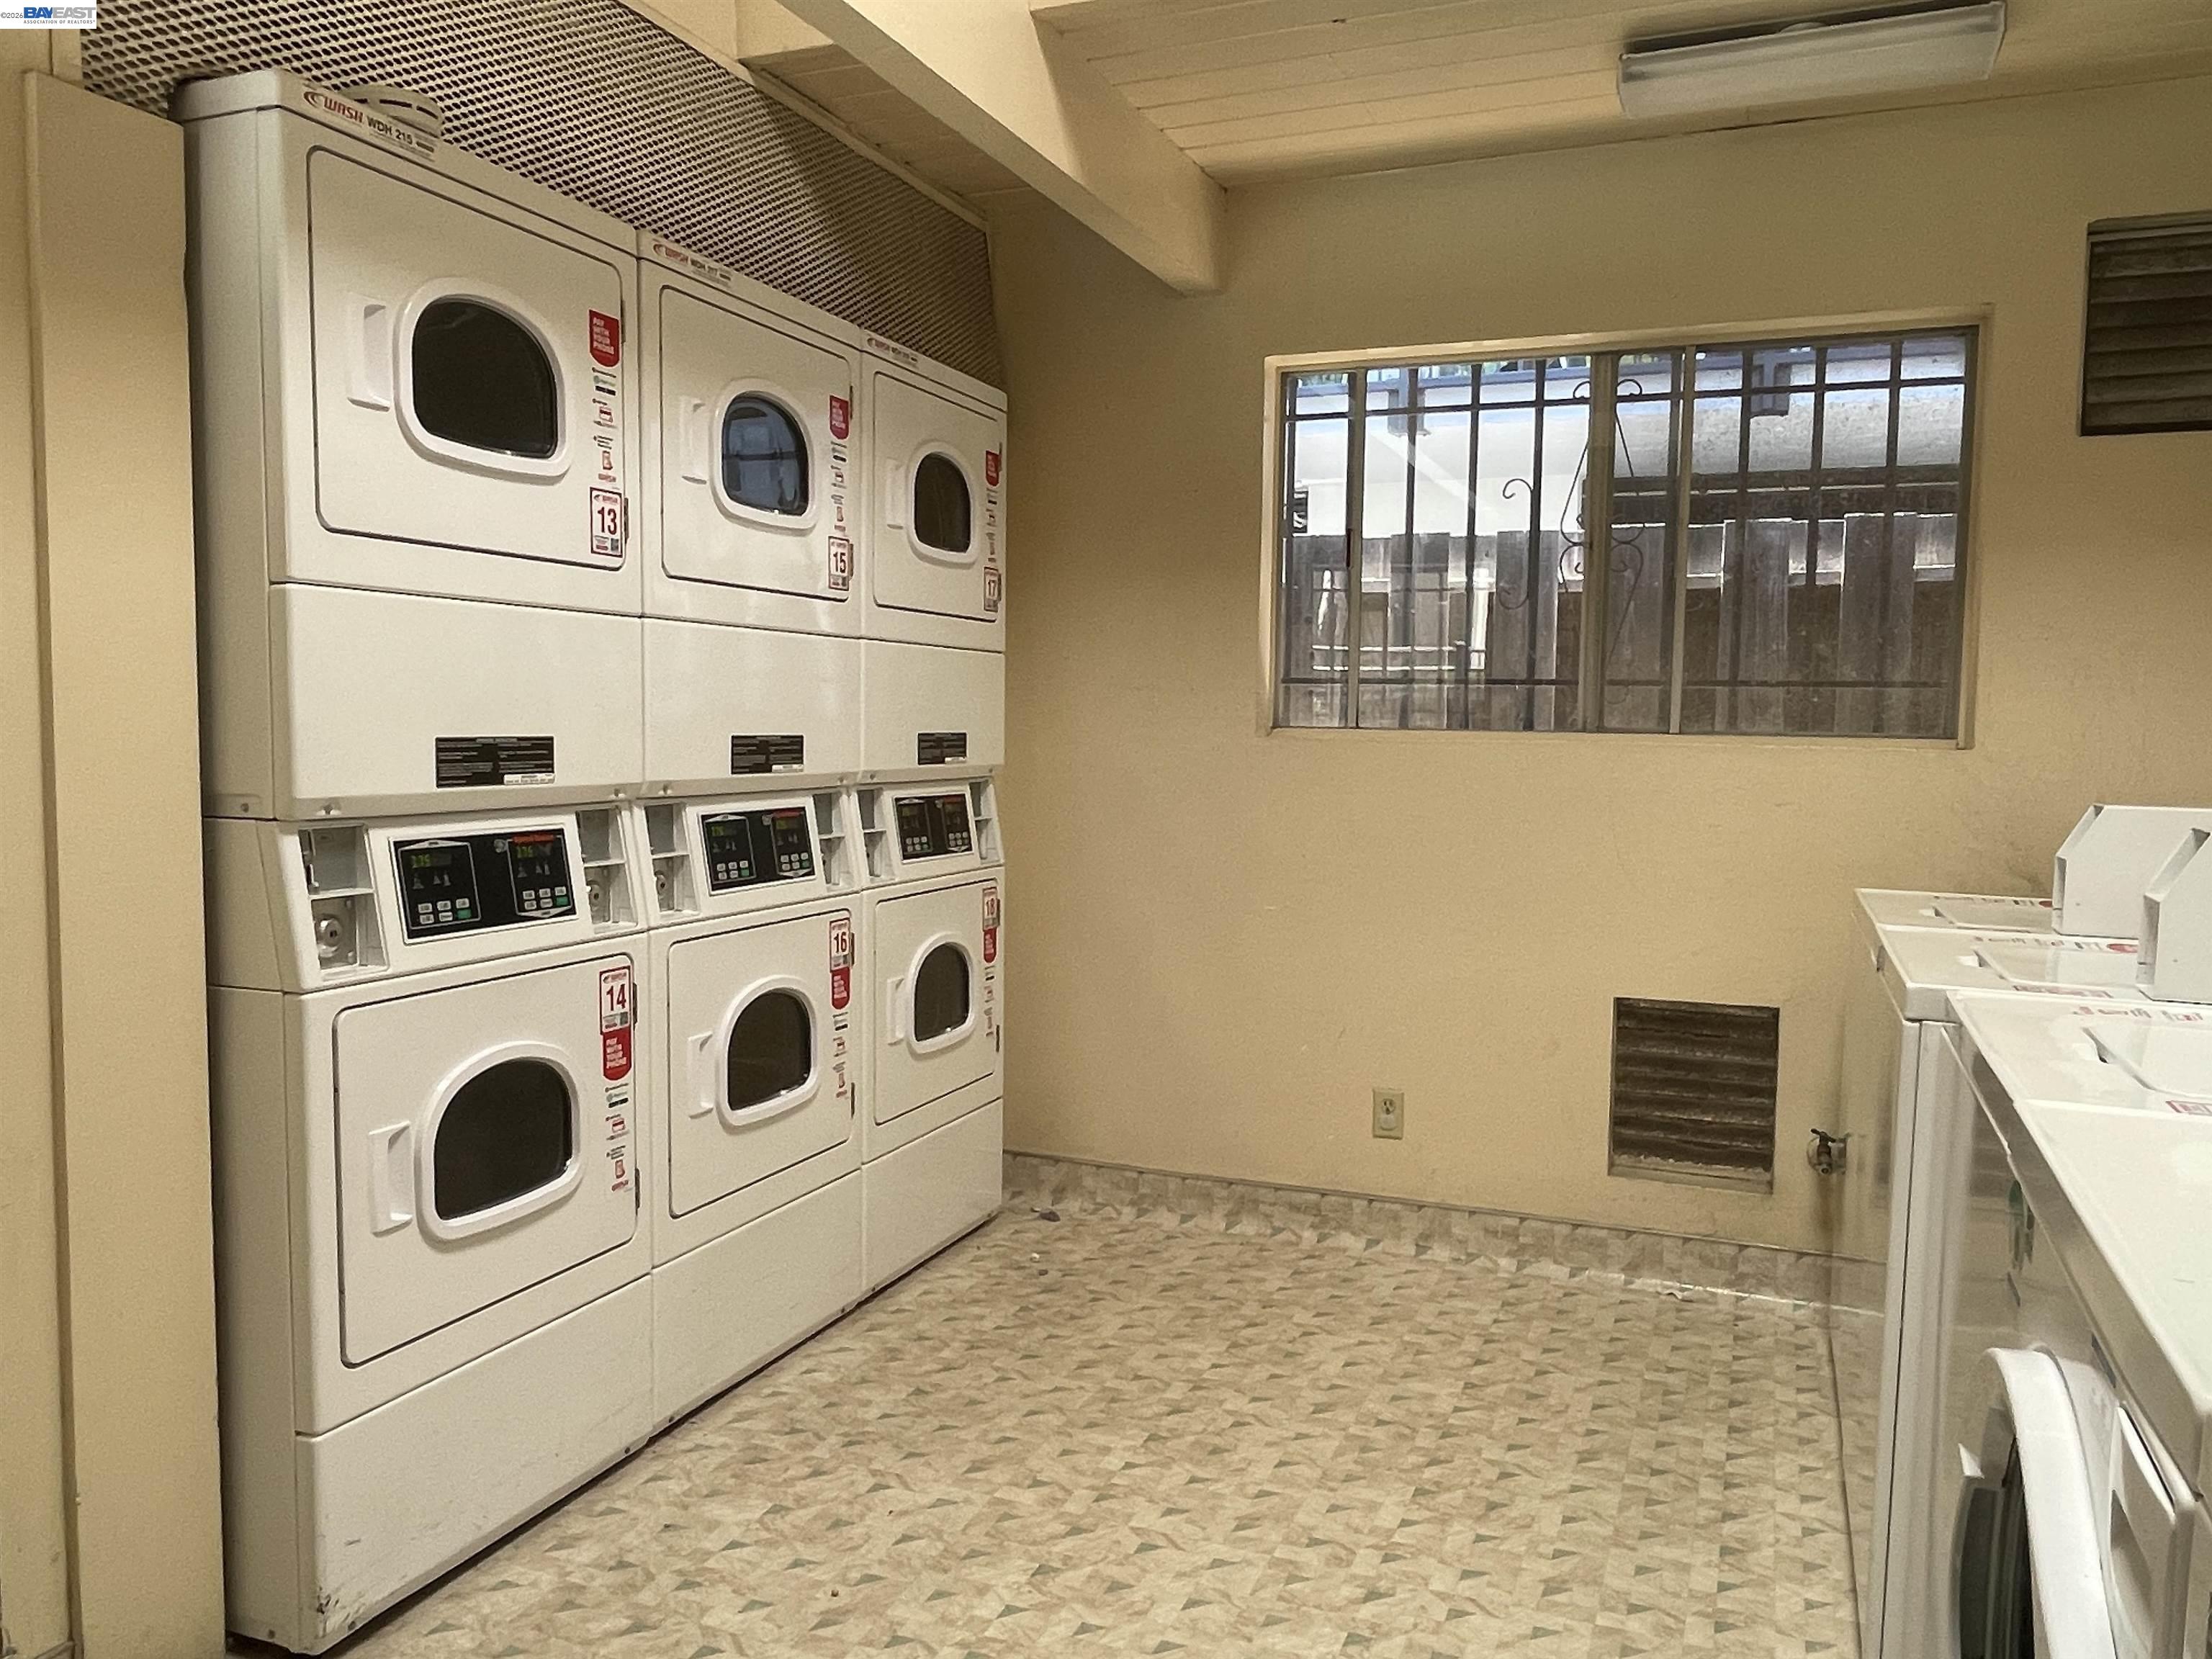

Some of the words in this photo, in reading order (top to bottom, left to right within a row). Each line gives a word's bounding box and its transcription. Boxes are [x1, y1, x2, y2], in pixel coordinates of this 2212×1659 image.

[367, 115, 392, 136] WDH
[395, 129, 413, 145] 215
[598, 507, 617, 535] 13
[833, 552, 846, 573] 15
[988, 580, 997, 597] 17
[986, 898, 995, 917] 18
[834, 932, 848, 954] 16
[606, 984, 626, 1012] 14
